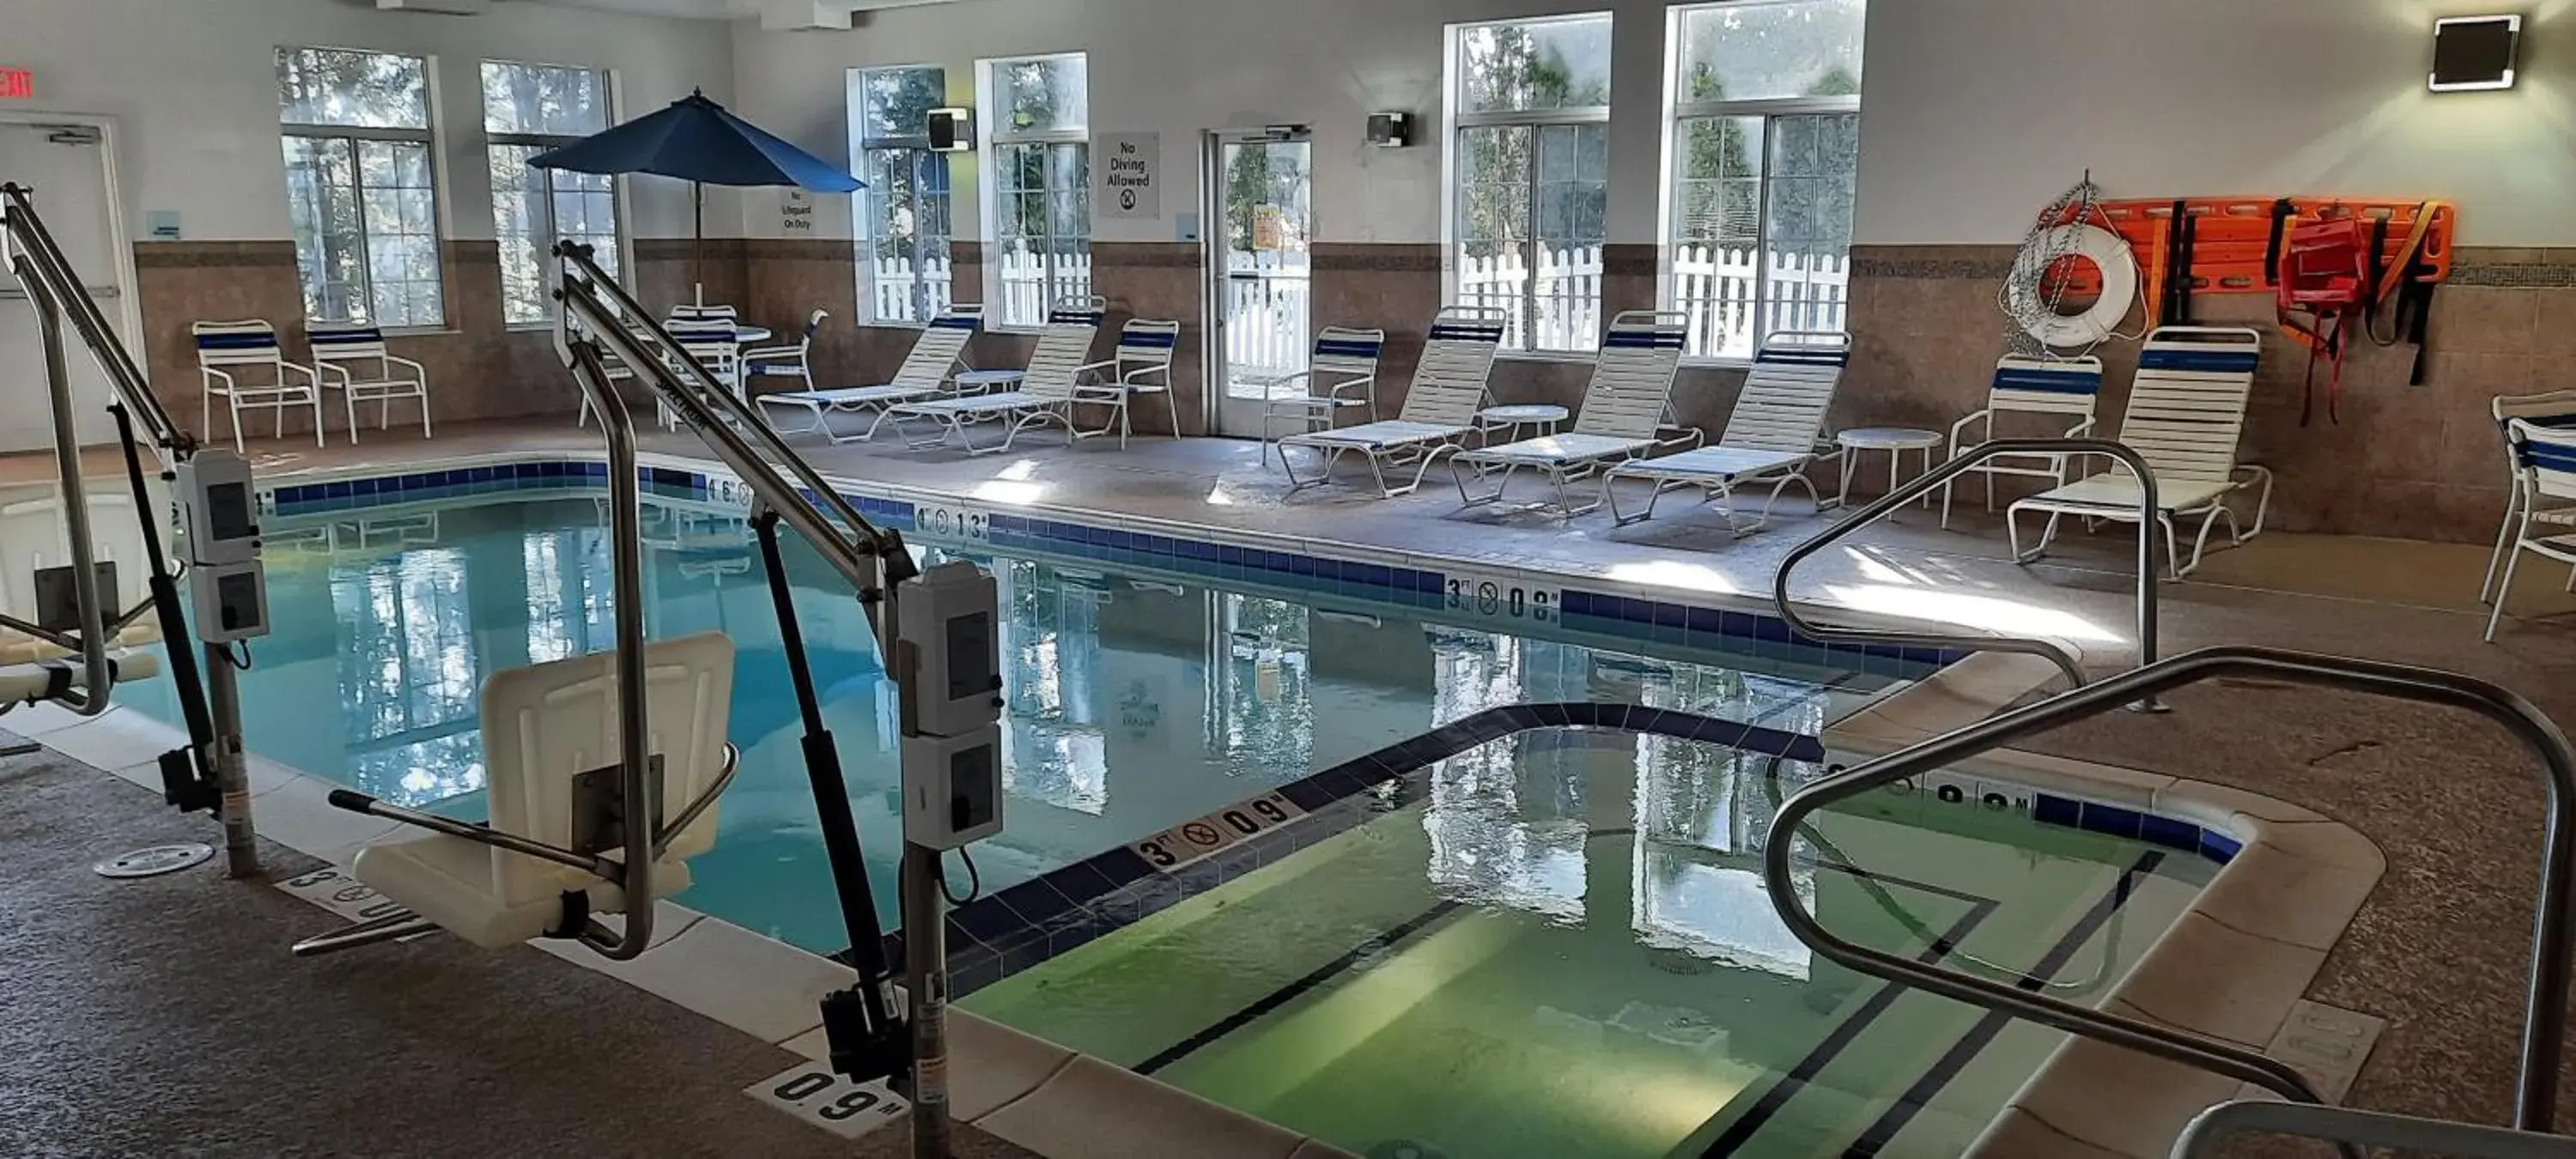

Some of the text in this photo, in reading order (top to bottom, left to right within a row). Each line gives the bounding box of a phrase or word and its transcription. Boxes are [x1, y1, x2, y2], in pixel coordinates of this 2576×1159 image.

[1120, 142, 1136, 154] No
[1110, 157, 1145, 173] Diving
[1107, 173, 1150, 186] Allowed
[1139, 841, 1176, 866] 3
